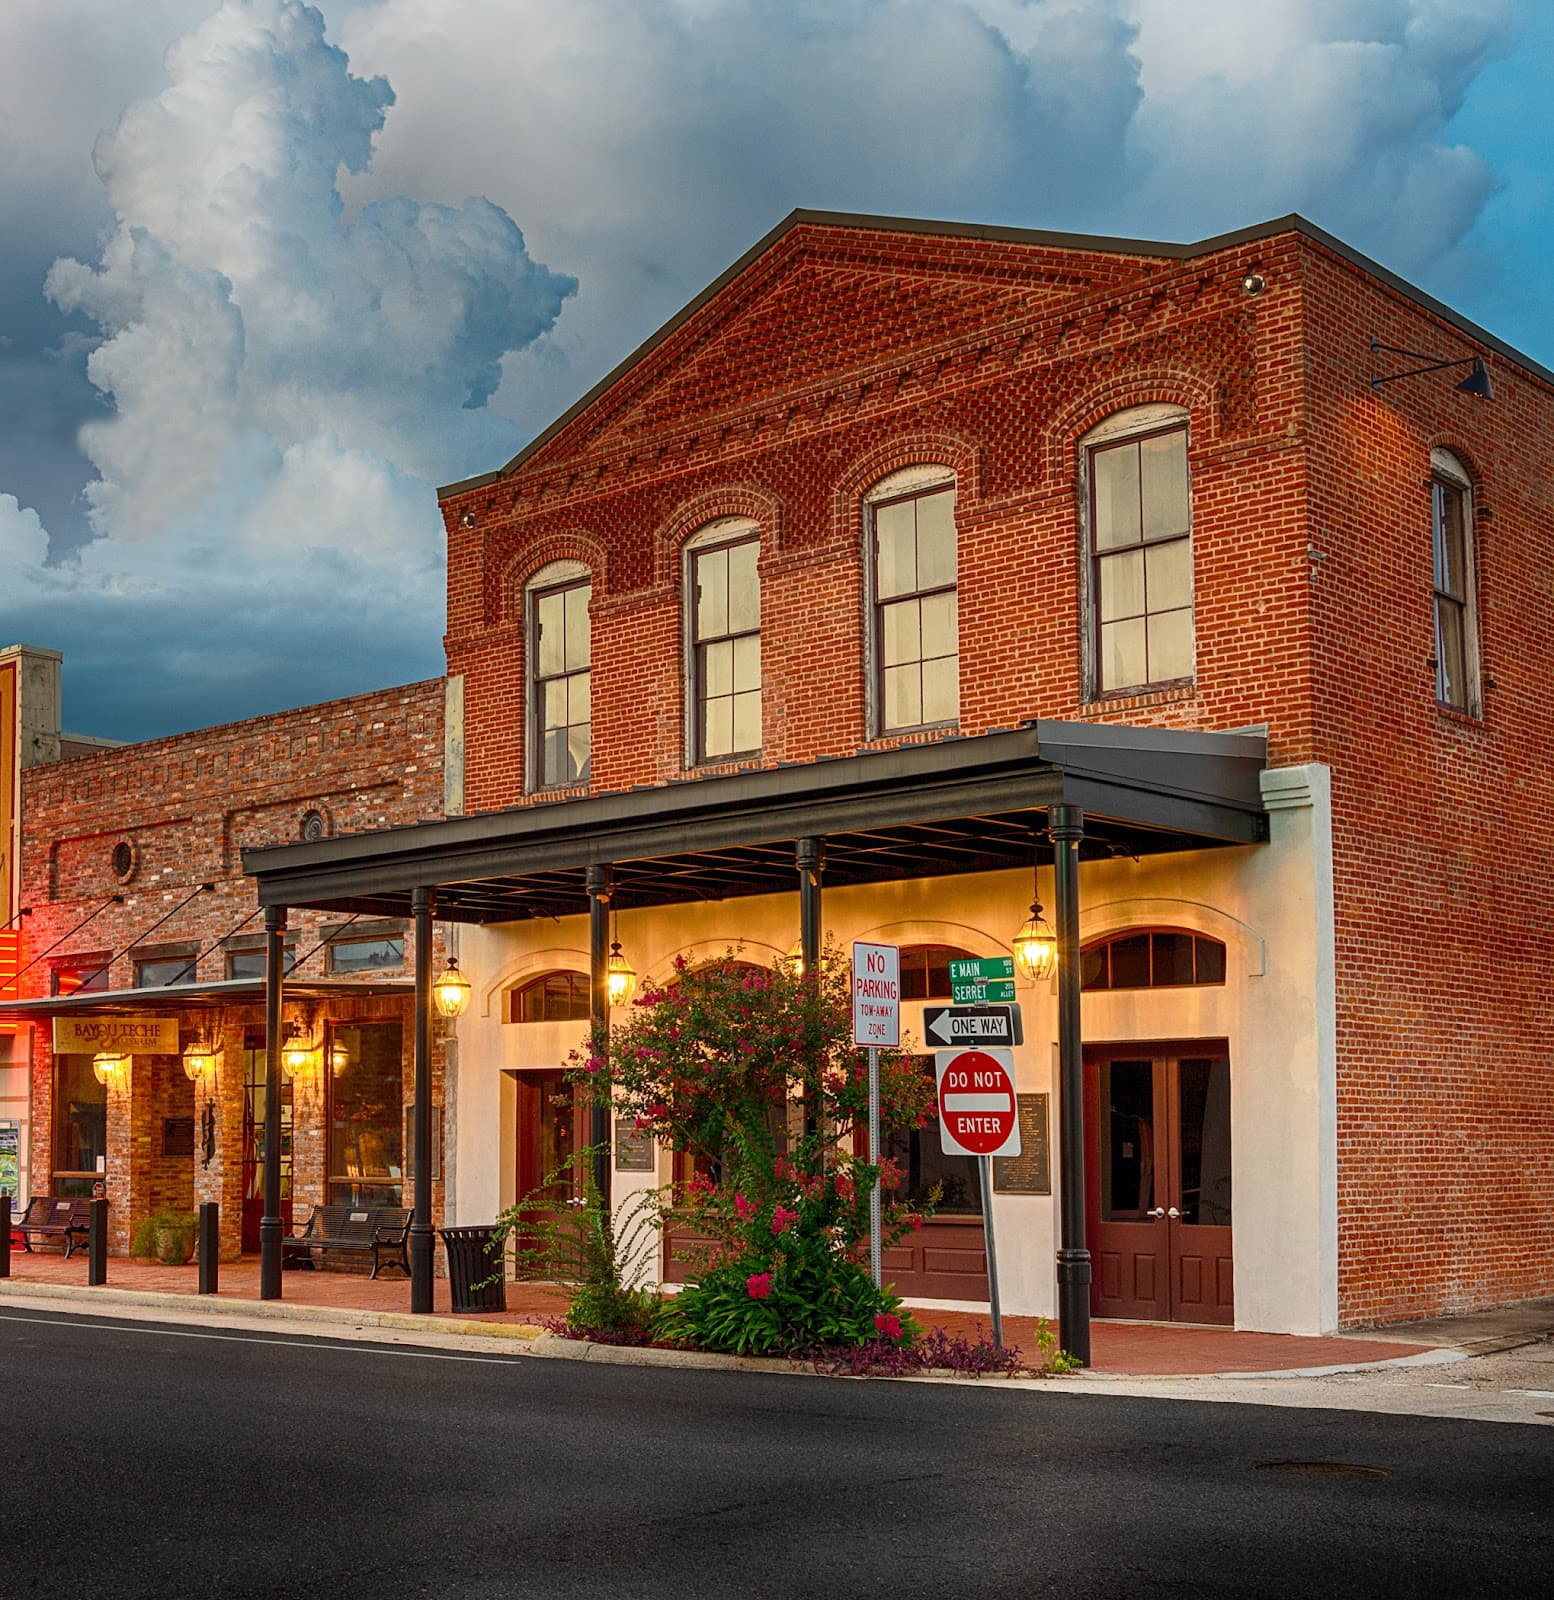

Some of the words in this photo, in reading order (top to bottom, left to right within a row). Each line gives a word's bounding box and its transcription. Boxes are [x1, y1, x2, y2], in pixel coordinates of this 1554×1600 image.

[867, 953, 885, 974] NO
[951, 964, 957, 978] E
[960, 962, 980, 977] MAIN
[856, 978, 897, 1000] PARKING
[955, 985, 986, 1000] SERRET
[861, 1004, 893, 1018] TOW-AWAY
[74, 1023, 117, 1038] BAYOU
[119, 1024, 160, 1037] TECHE
[868, 1023, 886, 1035] ZONE
[952, 1018, 976, 1034] ONE
[982, 1018, 1004, 1034] WAY
[949, 1072, 968, 1088] DO
[974, 1072, 1002, 1088] NOT
[957, 1118, 1001, 1134] ENTER
